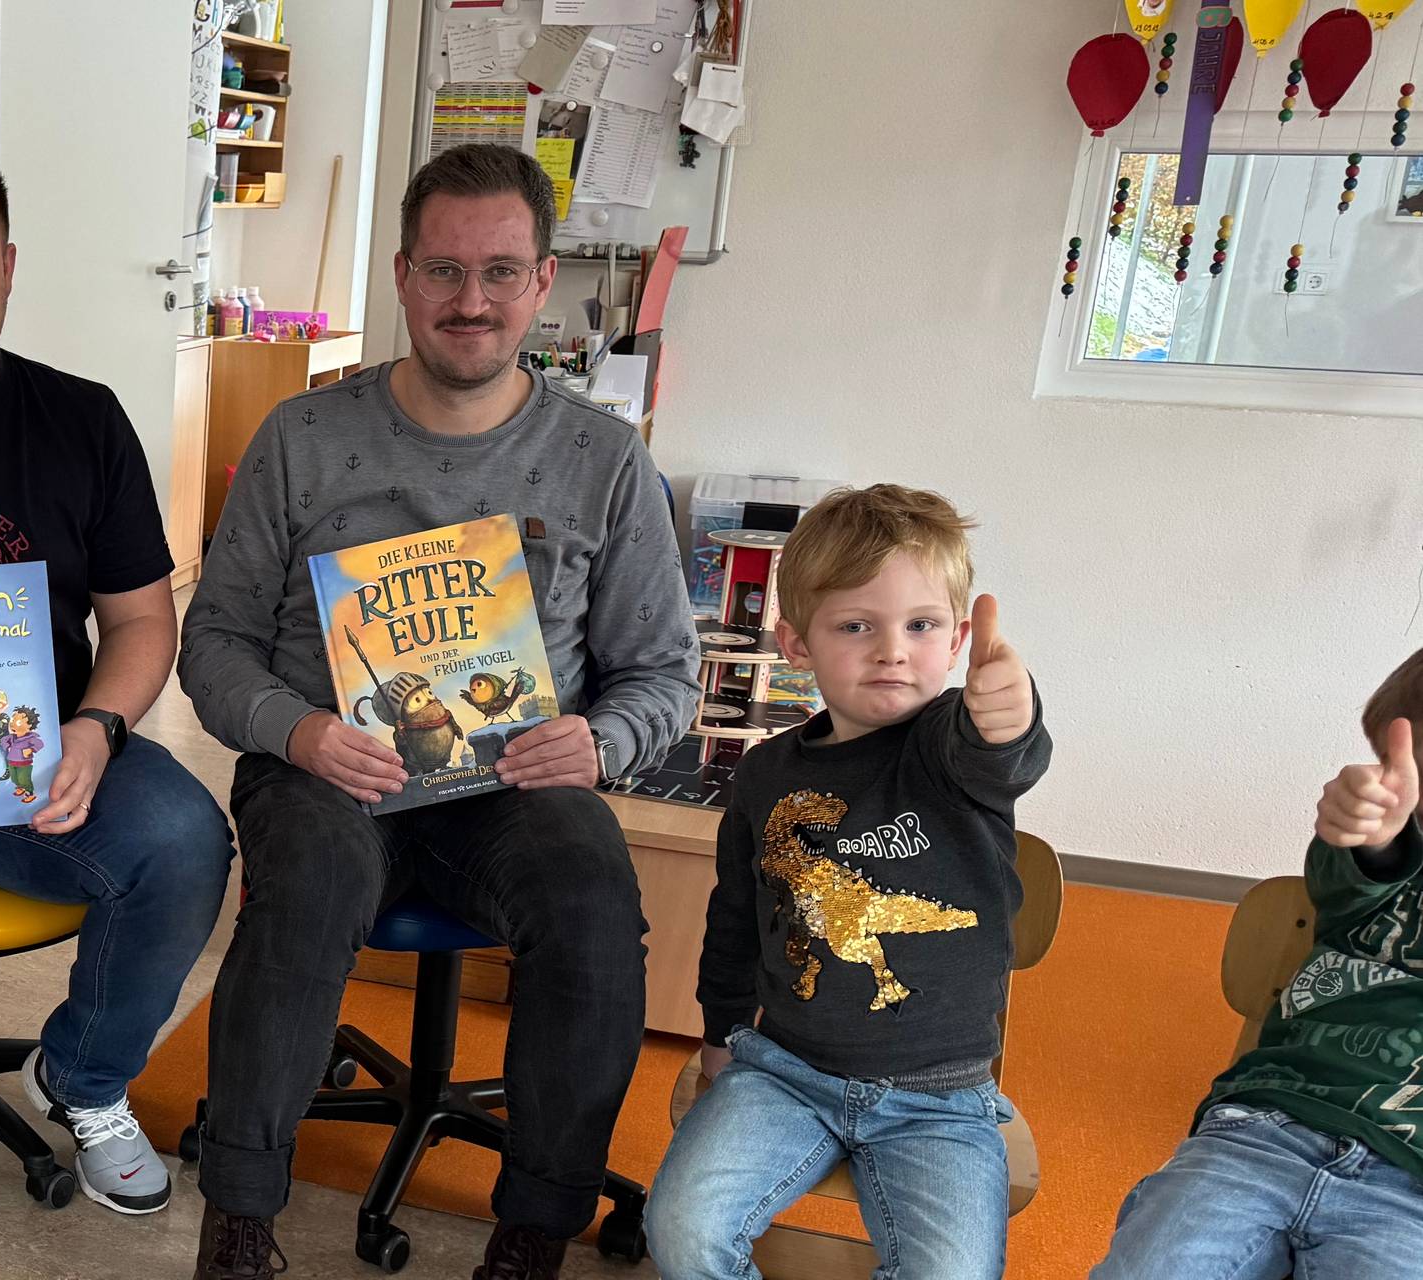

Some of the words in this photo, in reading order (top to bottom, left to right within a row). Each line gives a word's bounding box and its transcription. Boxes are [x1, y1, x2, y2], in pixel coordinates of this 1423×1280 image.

[377, 550, 403, 570] DIE
[404, 539, 457, 561] KLEINE
[353, 558, 497, 628] RITTER
[384, 604, 479, 657] EULE
[420, 651, 440, 664] UND
[441, 648, 461, 661] DER
[433, 655, 476, 677] FRÜHE
[477, 650, 516, 670] VOGEL
[422, 767, 478, 788] CHRISTOPHER
[837, 811, 931, 860] ROARR
